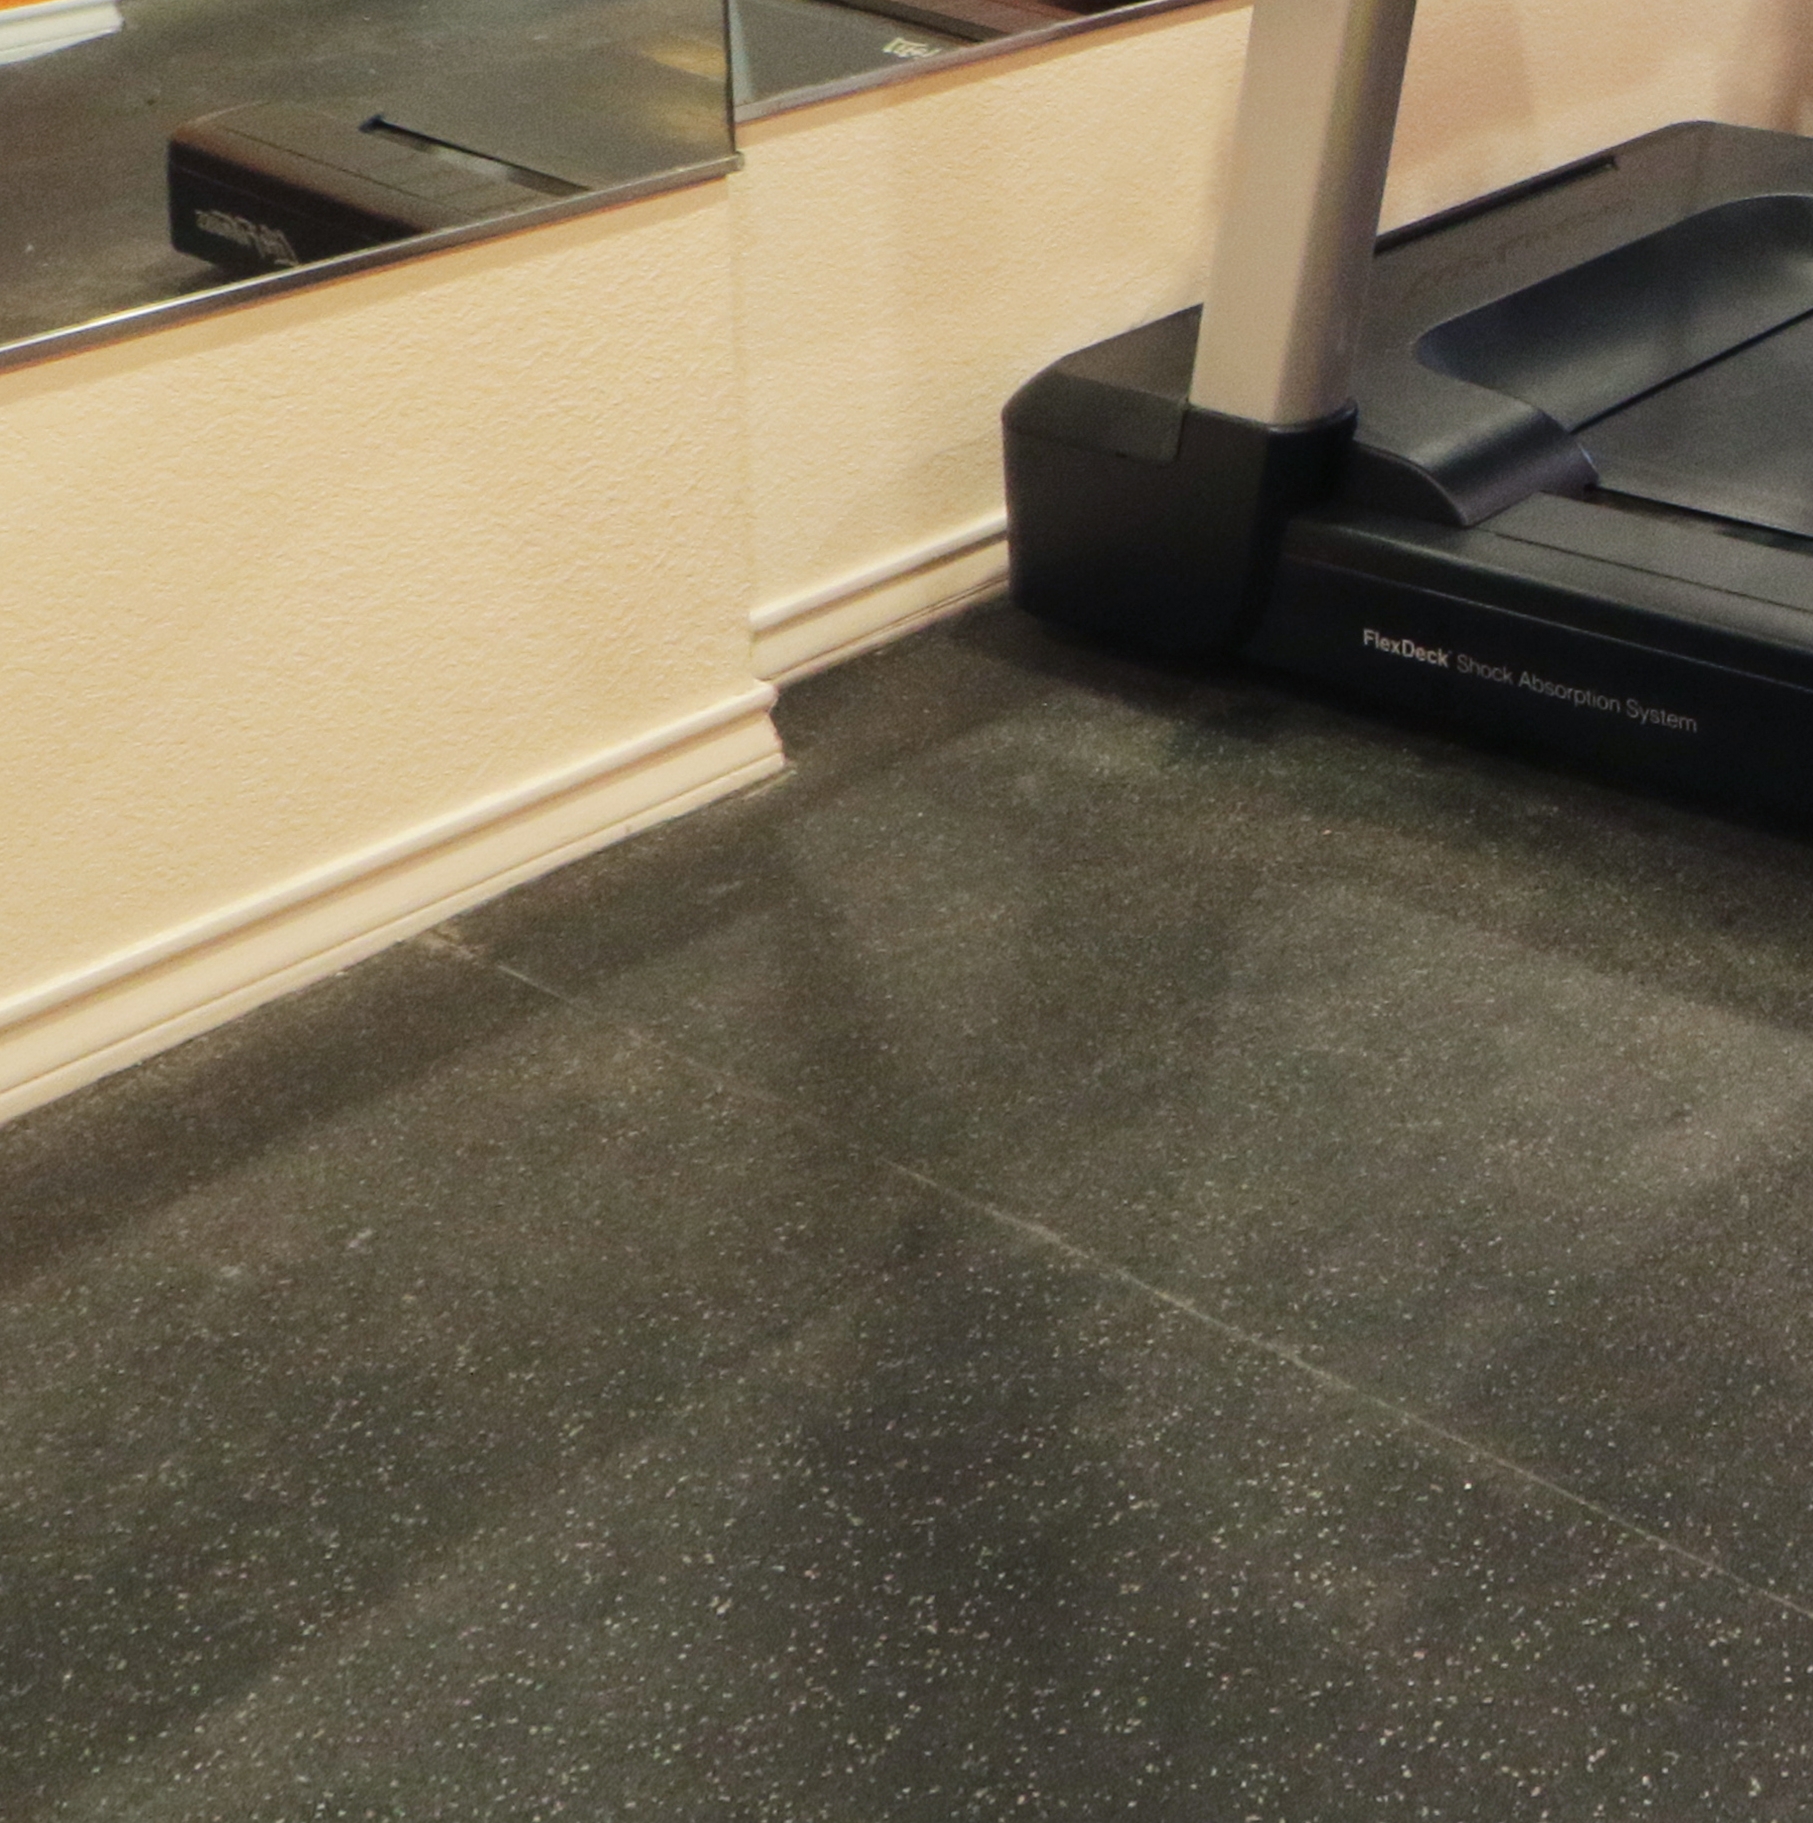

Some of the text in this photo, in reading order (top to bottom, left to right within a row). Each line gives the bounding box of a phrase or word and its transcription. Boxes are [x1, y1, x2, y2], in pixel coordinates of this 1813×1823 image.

[1363, 628, 1698, 733] FlexDeck Shock Absorption System
